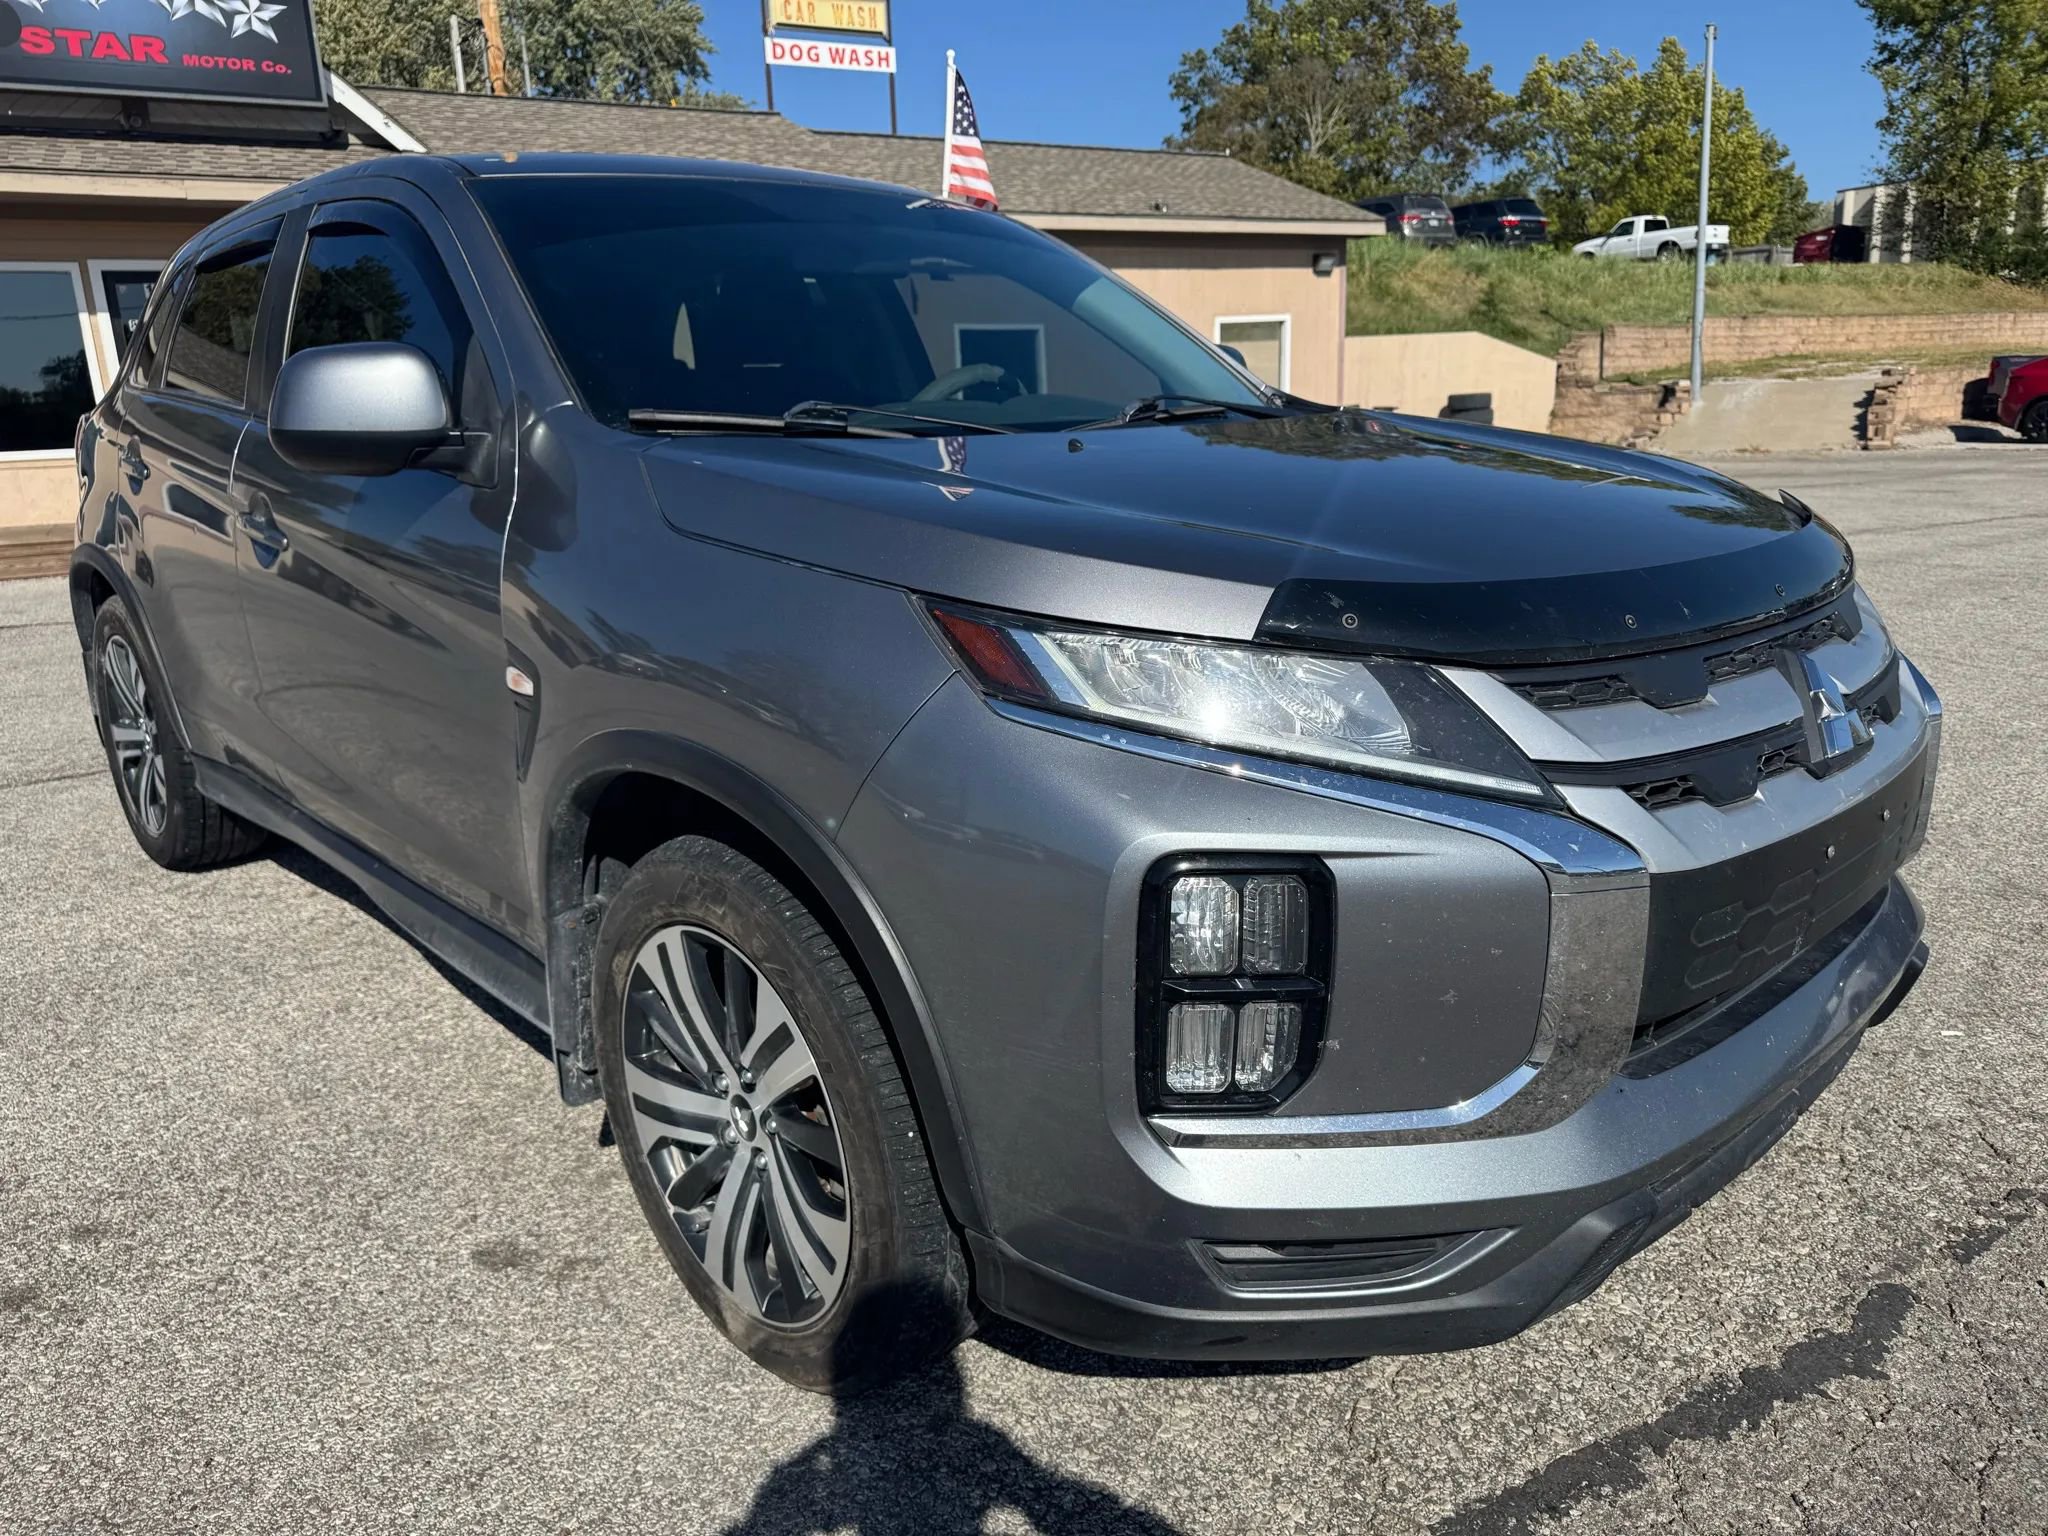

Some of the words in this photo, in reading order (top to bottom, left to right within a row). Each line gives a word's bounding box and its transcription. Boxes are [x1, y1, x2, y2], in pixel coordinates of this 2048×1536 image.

[783, 0, 816, 24] CAR
[832, 3, 877, 28] WASH
[20, 25, 169, 64] STAR
[182, 53, 257, 72] MOTOR
[261, 60, 293, 75] Co.
[771, 42, 820, 63] DOG
[829, 47, 890, 69] WASH
